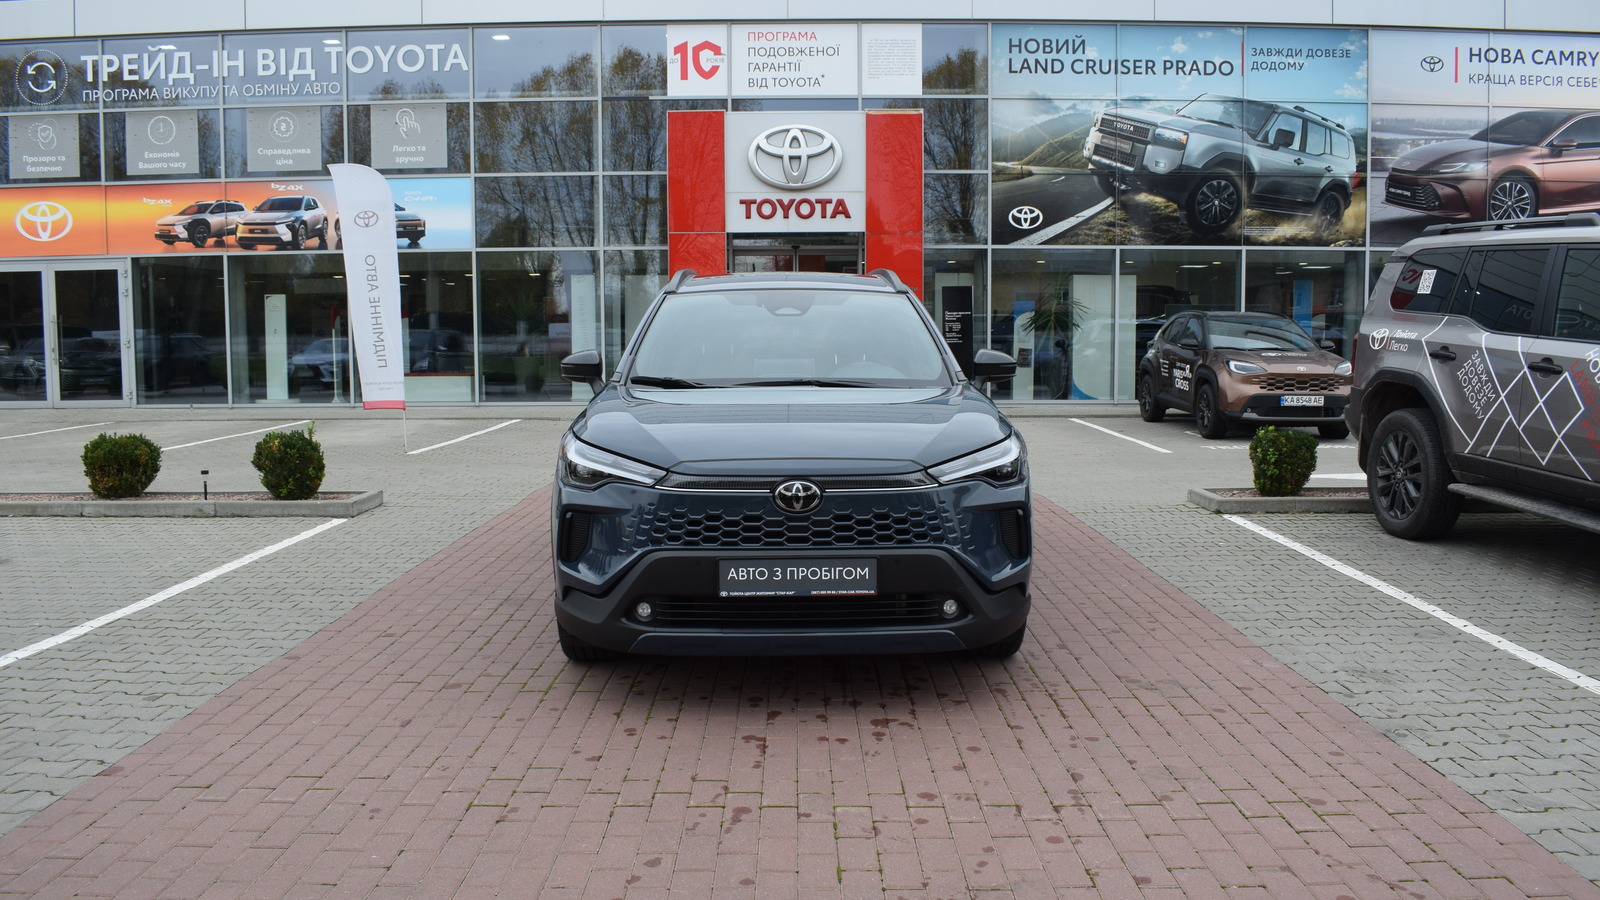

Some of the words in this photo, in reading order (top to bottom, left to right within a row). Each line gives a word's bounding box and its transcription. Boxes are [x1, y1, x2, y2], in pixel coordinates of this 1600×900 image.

[748, 31, 818, 42] ПРОГРАМА
[748, 44, 841, 59] ПОДОВЖЕНОЇ
[1008, 35, 1086, 55] НОВИЙ
[1251, 47, 1303, 60] ЗАВЖДИ
[1305, 48, 1351, 60] ДОВЕЗЕ
[1469, 47, 1526, 65] НОВА
[1531, 49, 1599, 67] CAMRY
[80, 45, 245, 86] ТРЕЙД-ІН
[257, 47, 316, 81] ВІД
[324, 43, 469, 74] TOYOTA
[748, 60, 801, 73] ГАРАНТІЇ
[1008, 58, 1065, 75] LAND
[1071, 58, 1156, 76] CRUISER
[1163, 59, 1234, 77] PRADO
[1251, 61, 1305, 72] ДОДОМУ
[748, 77, 768, 90] ВІД
[1469, 74, 1516, 87] КРАЩА
[1520, 75, 1563, 87] ВЕРСІЯ
[1567, 76, 1600, 88] СЕБЕ
[83, 87, 159, 102] ПРОГРАМА
[163, 85, 219, 100] ВИКУПУ
[222, 84, 239, 98] ТА
[243, 82, 300, 97] ОБМІНУ
[304, 81, 341, 95] АВТО
[1114, 121, 1135, 132] TOYOTA
[144, 150, 180, 159] Економія
[257, 147, 311, 156] Справедлива
[22, 155, 56, 164] Прозоро
[138, 161, 168, 169] Вашого
[168, 160, 187, 169] часу
[275, 156, 294, 166] ціна
[394, 155, 425, 164] зручно
[26, 164, 63, 173] безпечно
[739, 197, 852, 220] TOYOTA
[1471, 350, 1496, 402] ЗАВЖДИ
[1463, 360, 1488, 407] ДОВЕЗЕ
[1456, 368, 1485, 420] ДОДОМУ
[727, 567, 768, 580] АВТО
[773, 567, 782, 580] З
[787, 567, 869, 580] ПРОБІГОМ
